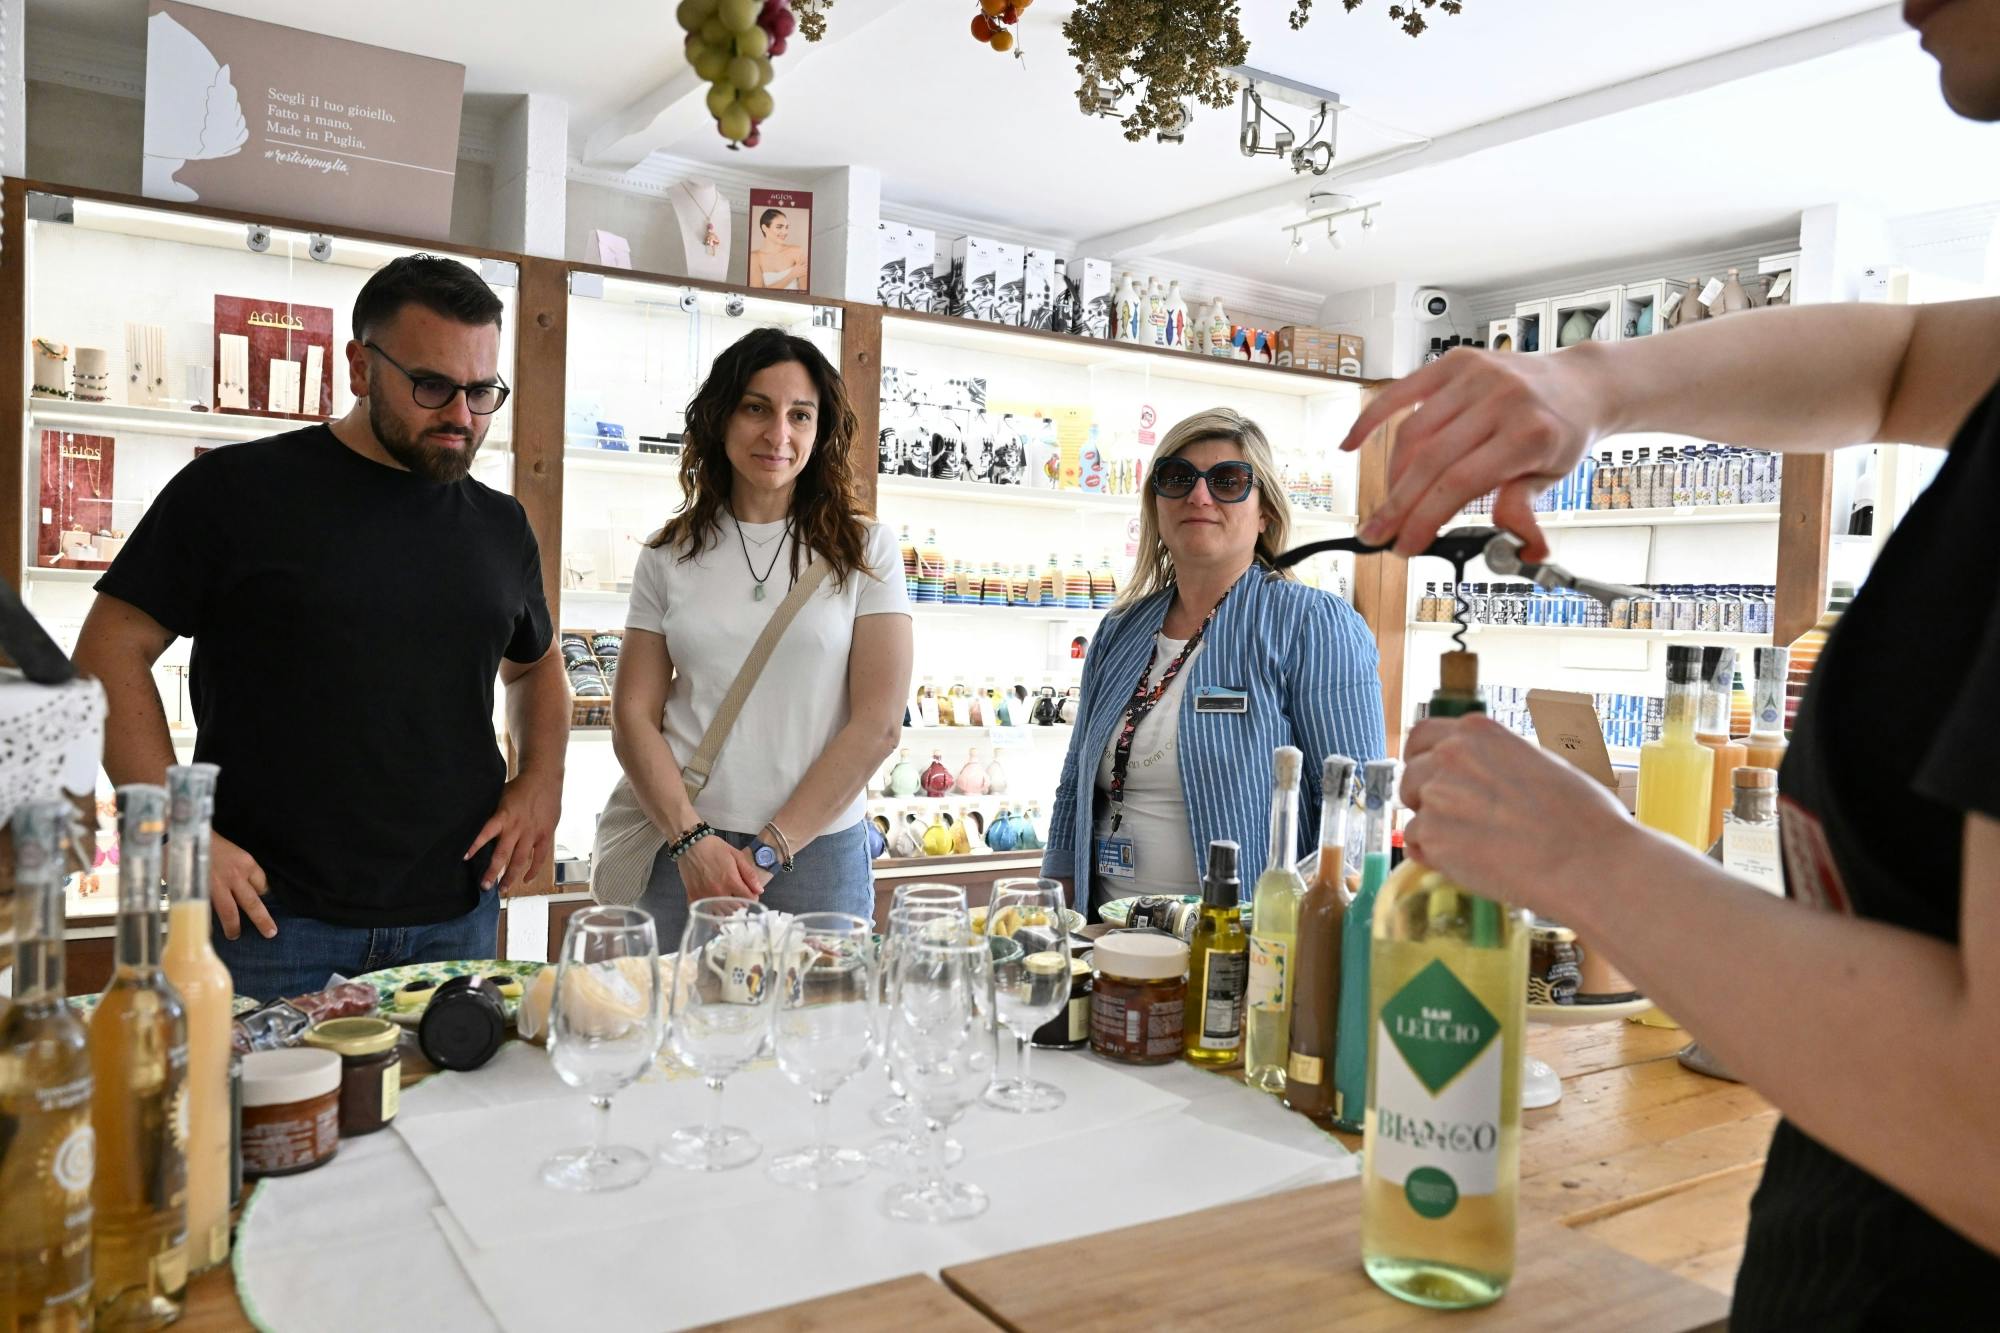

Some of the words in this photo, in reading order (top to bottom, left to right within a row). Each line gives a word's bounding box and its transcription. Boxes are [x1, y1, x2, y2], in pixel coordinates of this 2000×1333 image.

[267, 87, 305, 105] Scegli
[310, 96, 320, 108] il
[324, 100, 344, 114] tuo
[347, 105, 396, 123] gioiello.
[267, 103, 300, 122] Fatto
[303, 114, 311, 123] a
[315, 115, 354, 131] mano.
[266, 119, 302, 138] Made
[306, 127, 320, 141] in
[324, 130, 366, 149] Puglia.
[249, 311, 304, 328] AGIOS
[1421, 1007, 1452, 1020] SAN
[1396, 1016, 1479, 1043] LEUCIO
[1378, 1107, 1497, 1153] BIANCO
